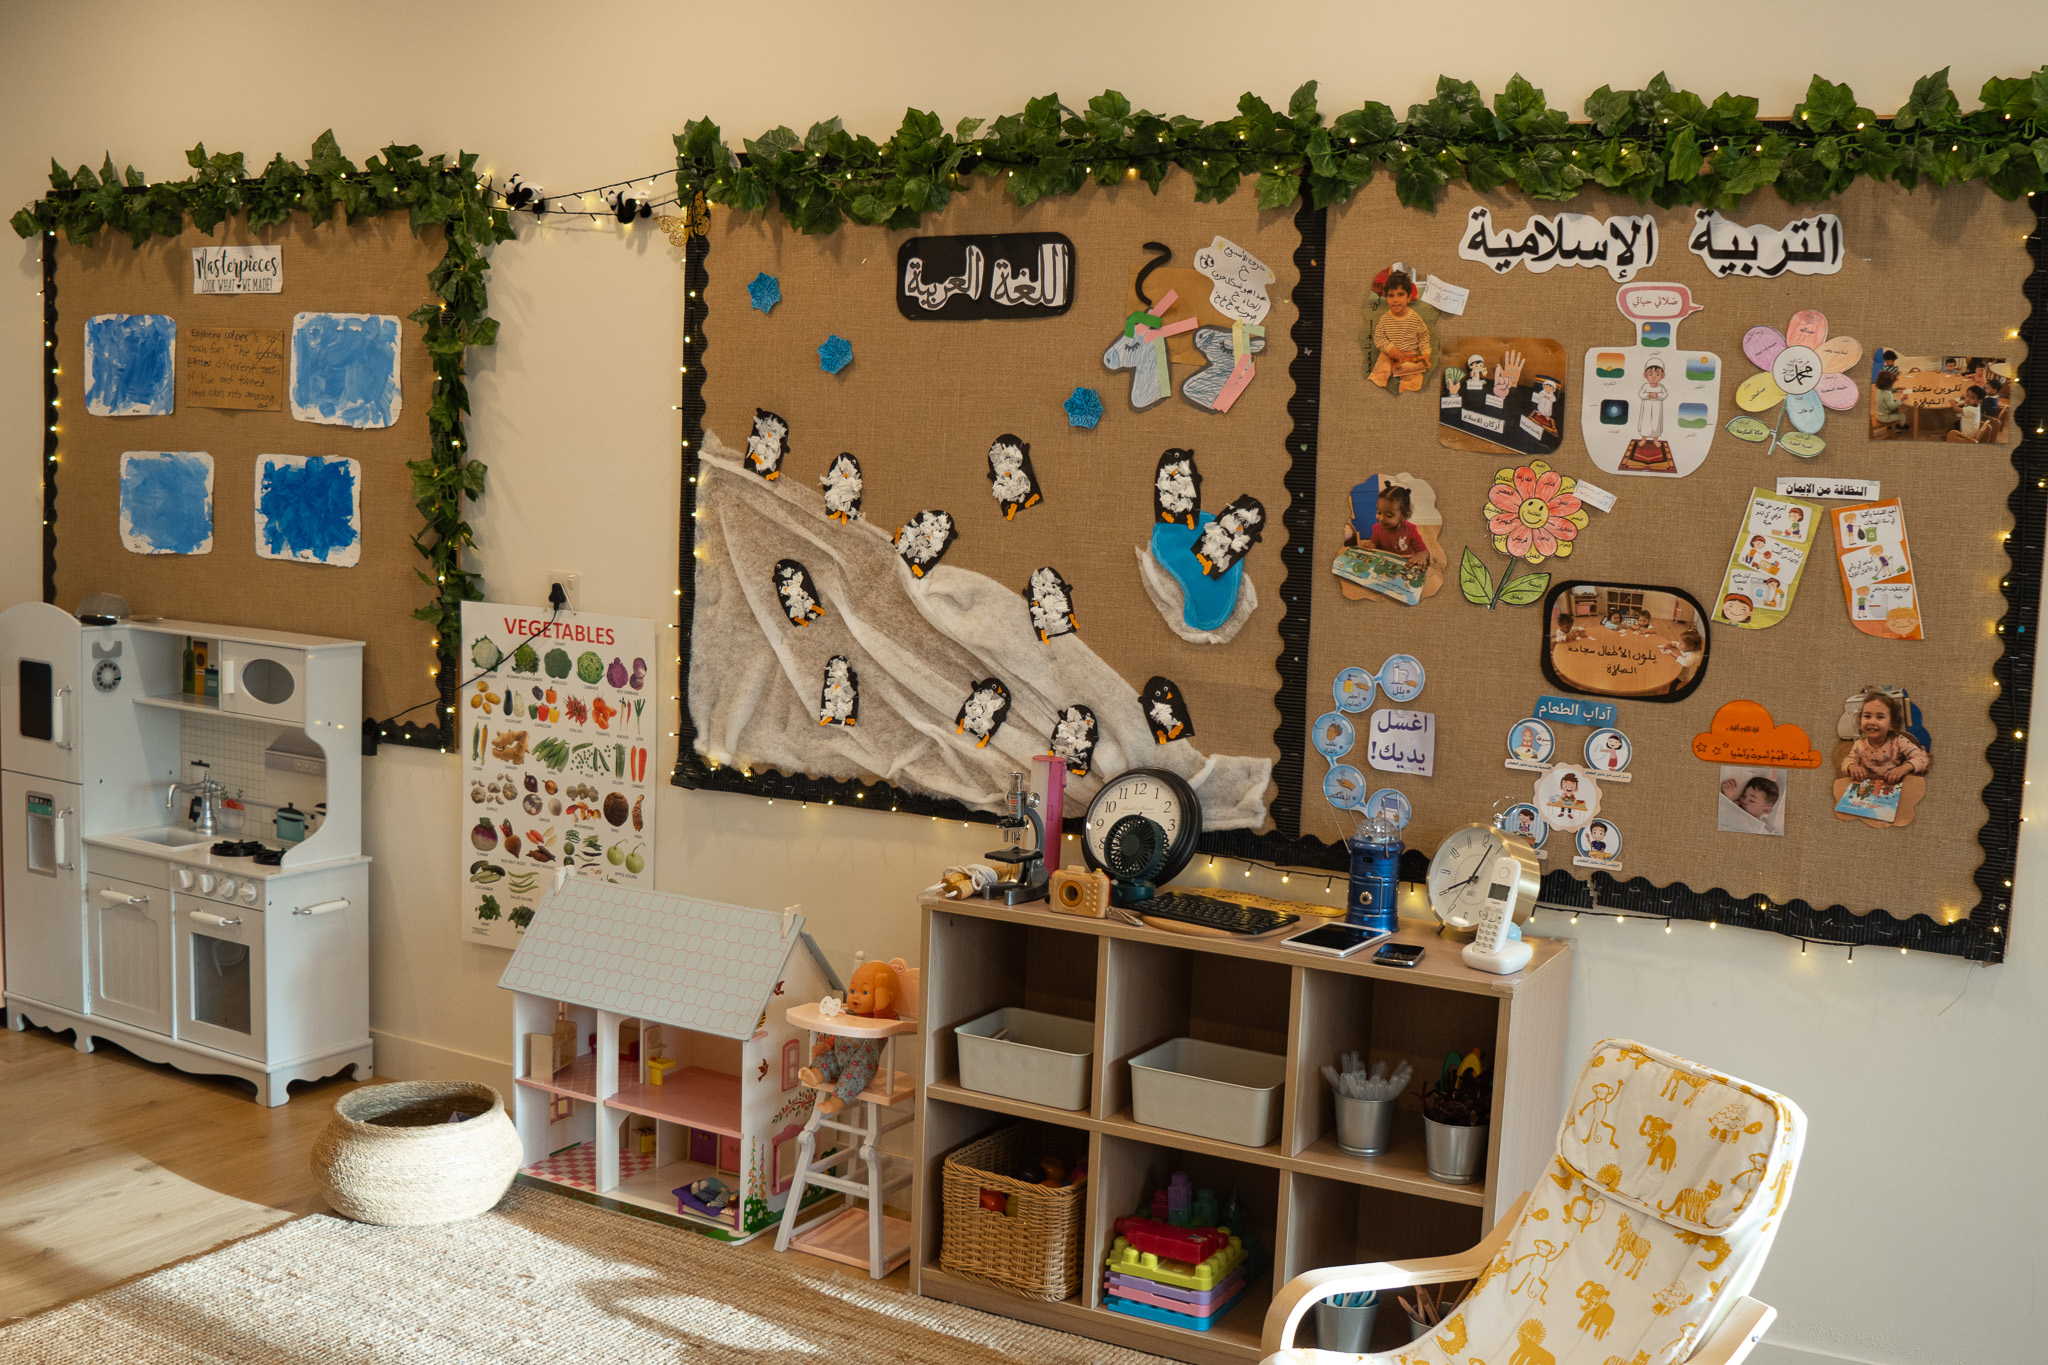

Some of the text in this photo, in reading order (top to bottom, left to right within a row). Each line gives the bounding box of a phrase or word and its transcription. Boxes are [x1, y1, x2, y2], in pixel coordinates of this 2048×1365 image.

[1467, 208, 1843, 280] التربية الإسلامية
[195, 248, 279, 282] Masterpieces
[907, 243, 1069, 309] اللغة العربية
[202, 278, 273, 292] LOOK WHAT WE MADE!
[1632, 296, 1652, 308] حياتي
[191, 328, 220, 341] Exploring
[225, 329, 248, 343] colors
[188, 344, 207, 354] much
[233, 344, 250, 357] The
[215, 358, 255, 374] different
[219, 374, 233, 385] and
[239, 376, 265, 388] turned
[1786, 482, 1867, 497] النظافة من الإيمان
[503, 616, 616, 646] VEGETABLES
[1539, 701, 1612, 722] آداب الطعام
[1377, 711, 1428, 733] اغسل
[1371, 741, 1426, 771] يديك!
[1118, 787, 1129, 800] 11
[1134, 783, 1148, 795] 12
[1154, 787, 1160, 800] 1
[1104, 800, 1117, 813] 10
[1163, 800, 1172, 813] 2
[1096, 818, 1105, 831] 9
[1167, 818, 1176, 832] 3
[1466, 835, 1473, 849] 11
[1481, 833, 1491, 848] 12
[1450, 847, 1460, 860] 10
